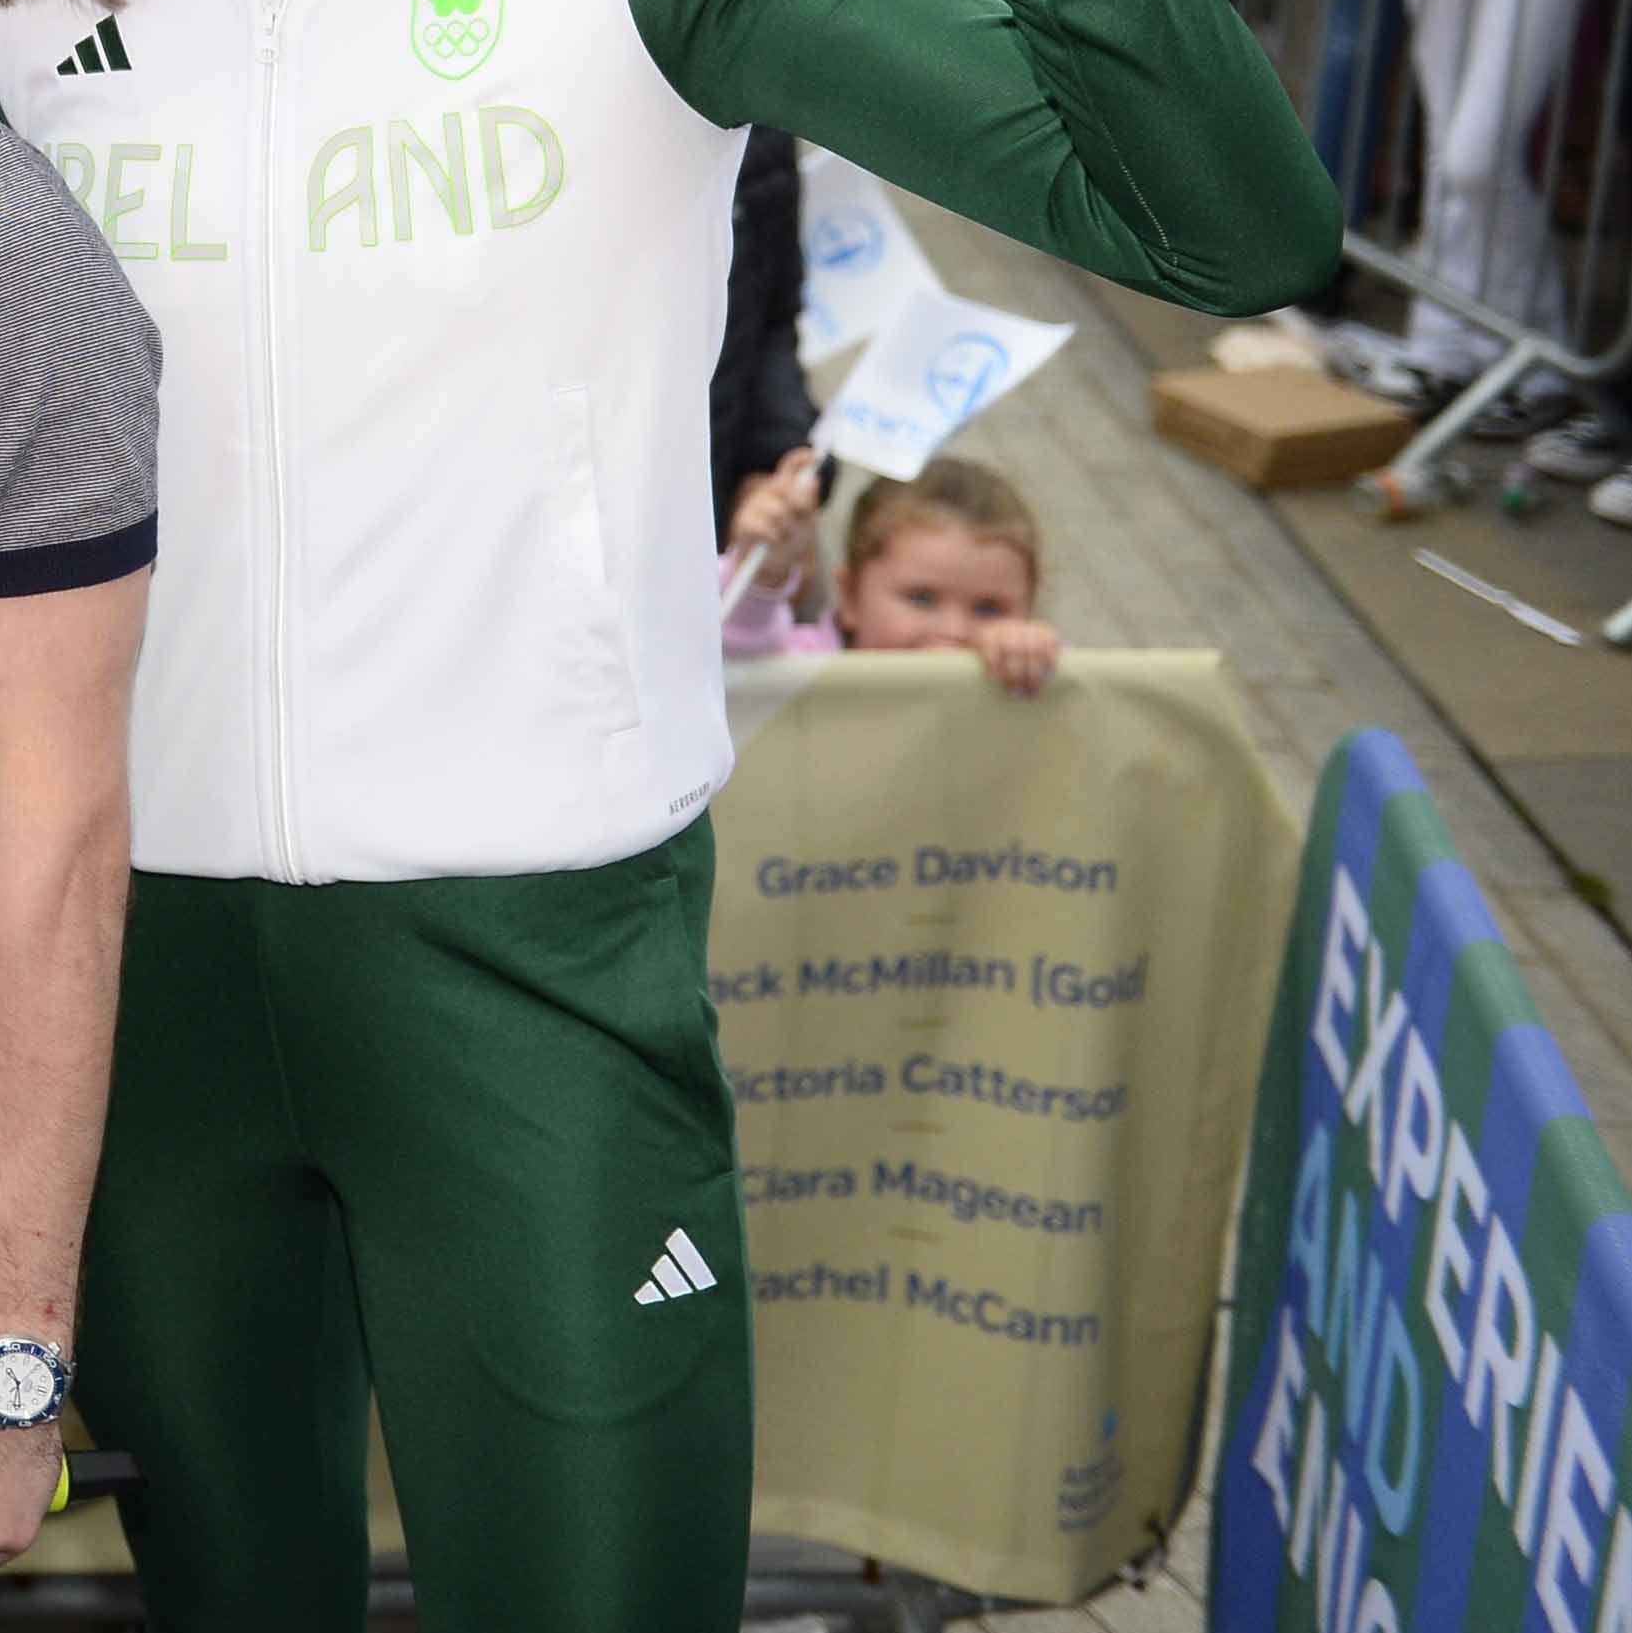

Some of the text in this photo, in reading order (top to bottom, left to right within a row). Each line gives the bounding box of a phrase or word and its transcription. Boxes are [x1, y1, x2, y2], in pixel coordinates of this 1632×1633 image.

[306, 105, 566, 253] AND
[757, 842, 1120, 898] Grace Davison
[708, 963, 782, 1005] ack
[799, 948, 1017, 996] McMillan
[731, 1052, 1128, 1122] ictoria Catterso
[739, 1160, 1107, 1236] Ciara Mageean
[751, 1261, 1103, 1347] achel McCann
[1288, 1122, 1425, 1537] AND
